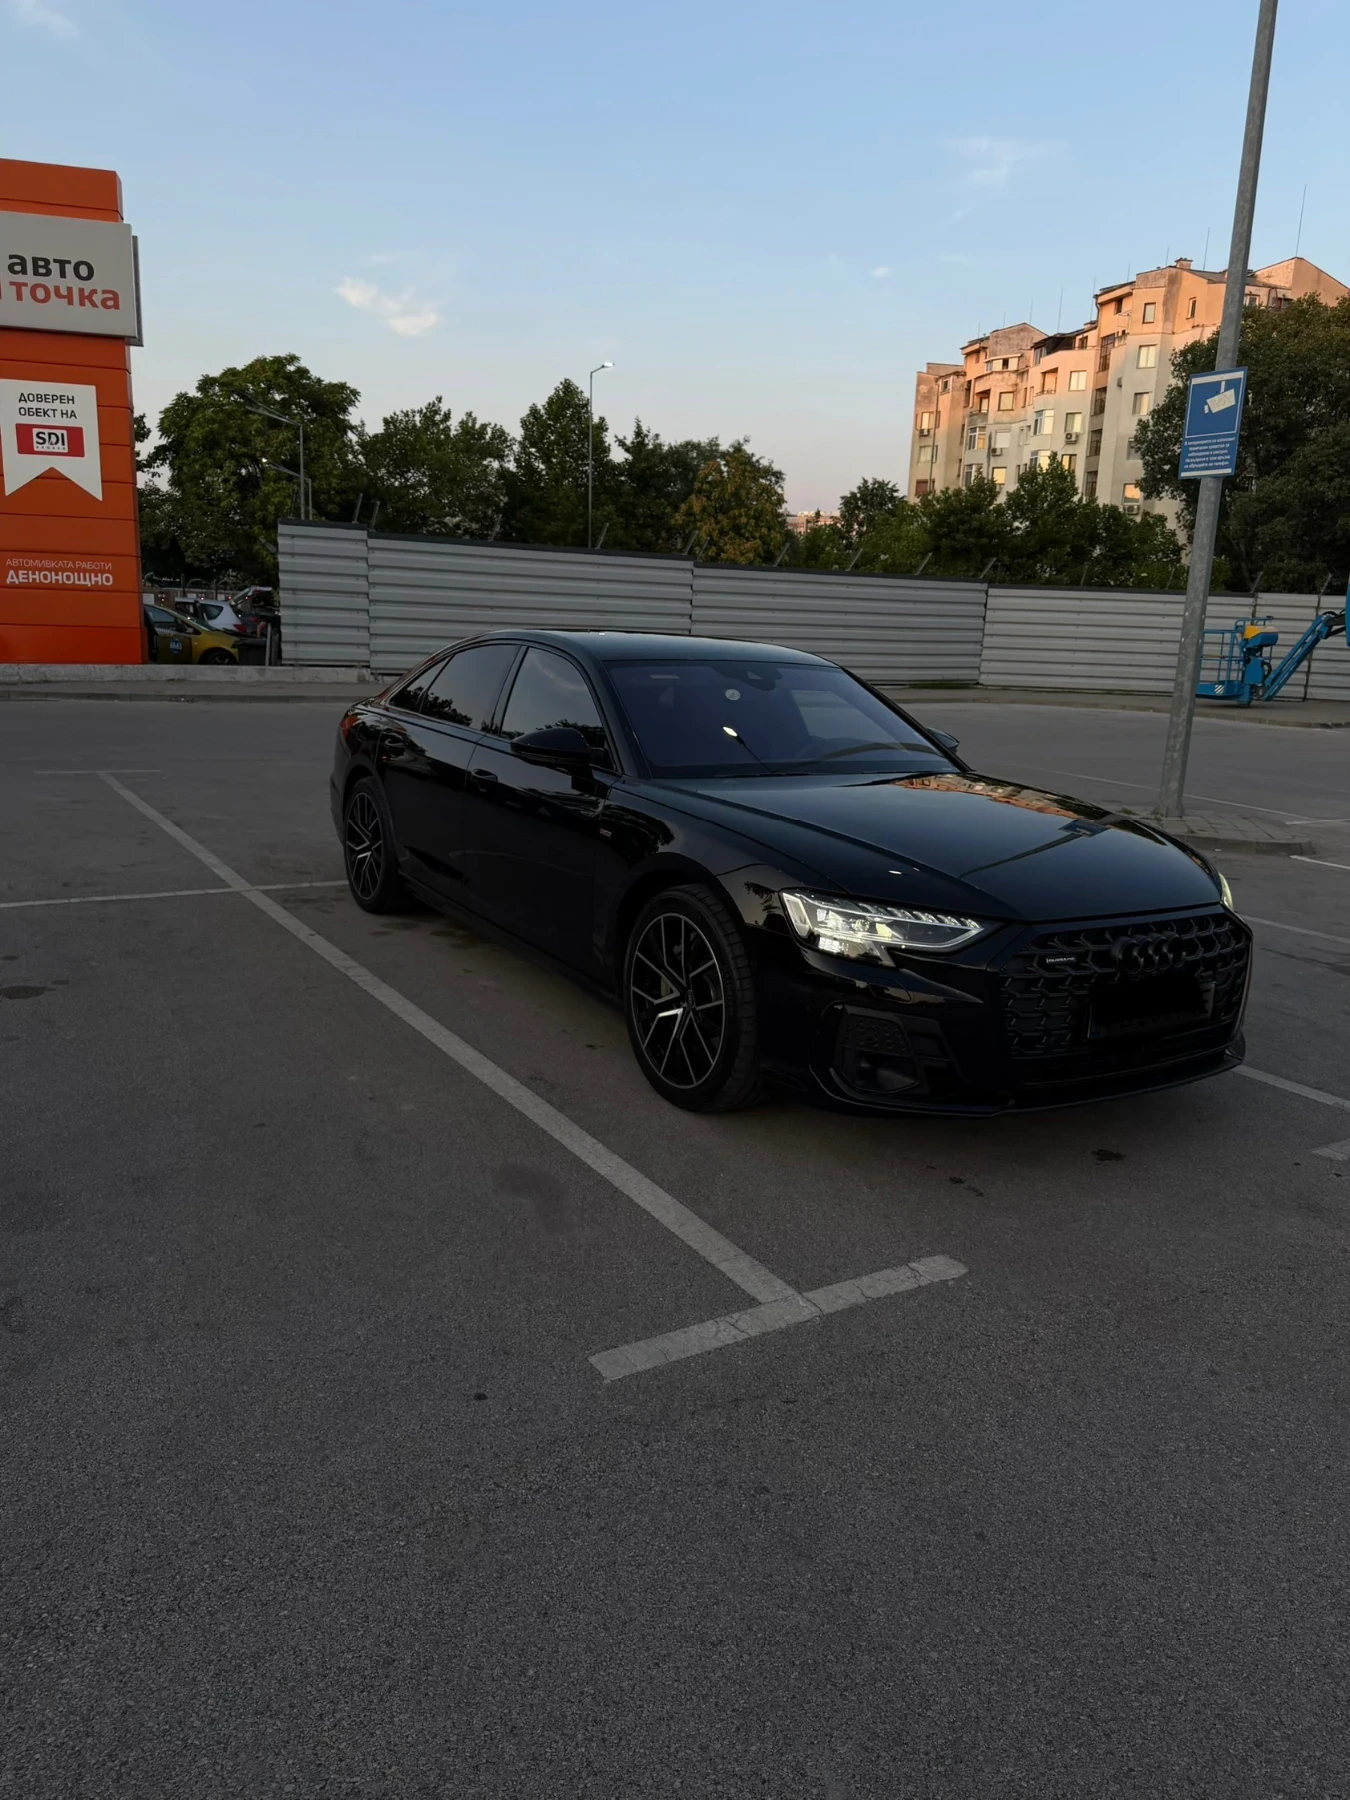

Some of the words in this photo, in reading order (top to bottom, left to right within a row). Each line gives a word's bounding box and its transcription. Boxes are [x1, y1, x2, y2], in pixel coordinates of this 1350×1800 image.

[8, 254, 95, 281] авто
[9, 281, 120, 311] точка
[18, 392, 75, 404] ДОВЕРЕН
[18, 407, 58, 418] ОБЕКТ
[61, 409, 77, 419] НА
[35, 431, 65, 446] SDI
[5, 558, 74, 569] АВТОМИВКАТА
[75, 561, 112, 570] РАБОТИ
[6, 569, 113, 587] ДЕНОНОЩНО
